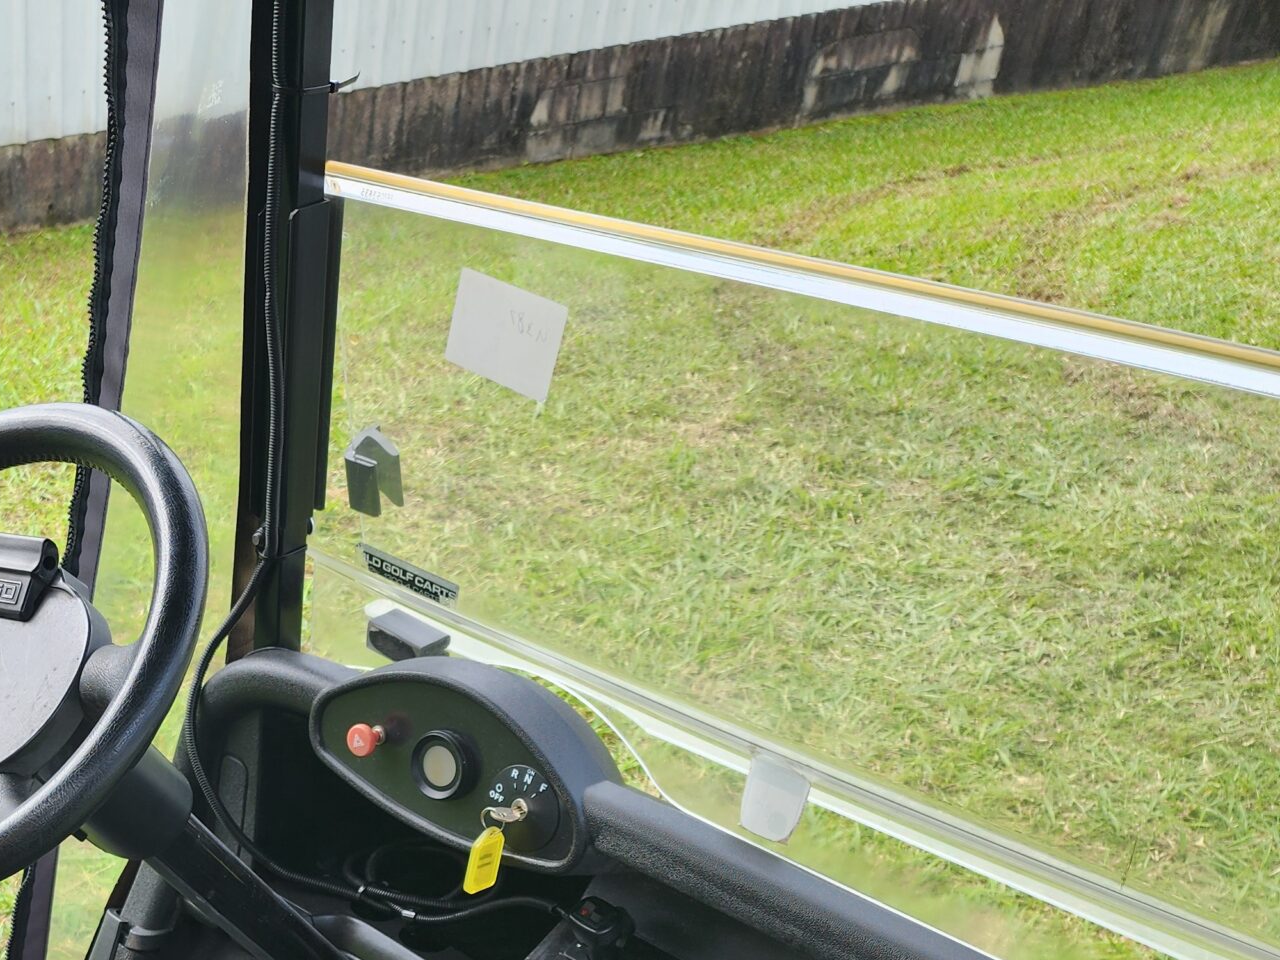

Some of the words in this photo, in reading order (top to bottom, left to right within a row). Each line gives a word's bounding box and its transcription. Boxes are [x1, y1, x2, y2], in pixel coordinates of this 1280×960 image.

[382, 561, 414, 581] GOLF
[414, 576, 457, 598] CARTS
[511, 768, 519, 779] R
[523, 773, 533, 785] N
[539, 783, 548, 792] F
[489, 789, 504, 803] OFF
